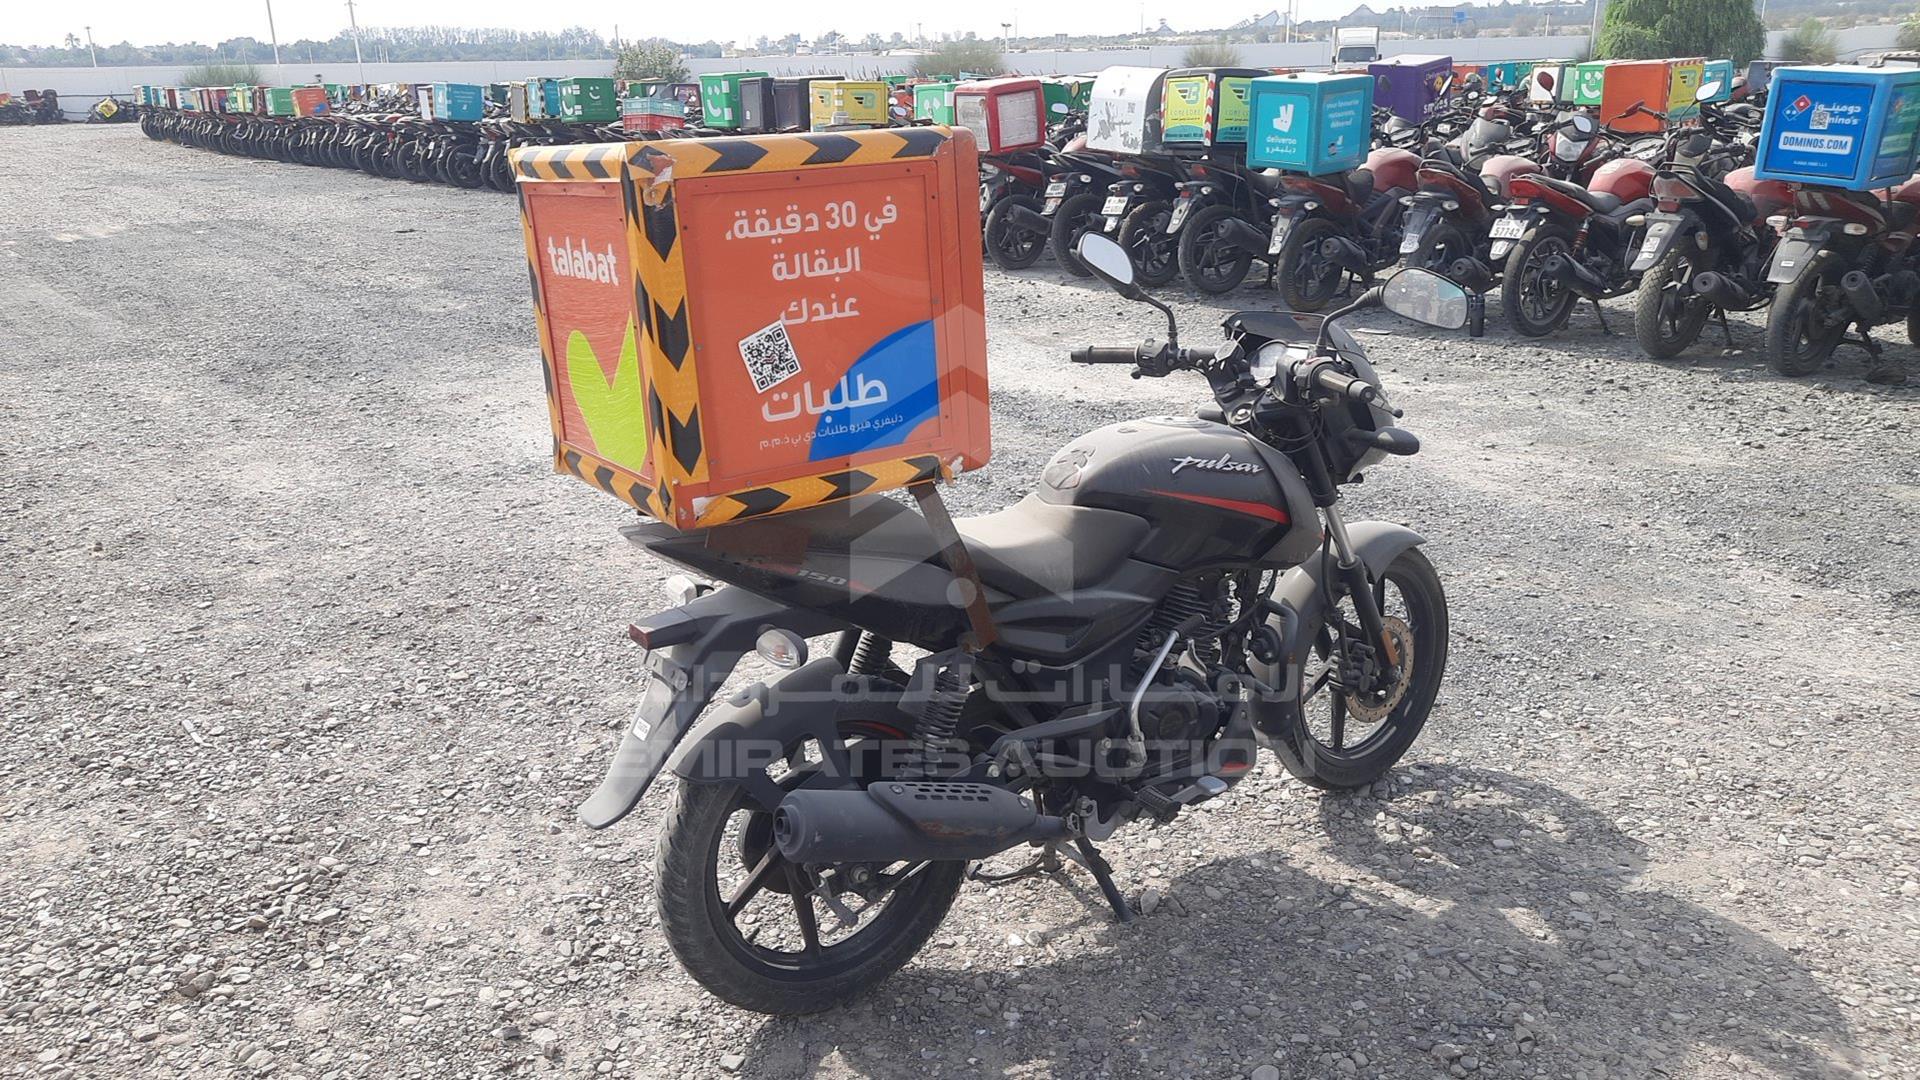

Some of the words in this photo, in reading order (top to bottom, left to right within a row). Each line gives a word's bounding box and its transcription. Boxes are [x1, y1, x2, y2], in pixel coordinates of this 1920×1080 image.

[1782, 136, 1848, 150] DOMINOS.COM
[825, 200, 857, 230] 30
[864, 196, 898, 240] في
[1494, 226, 1520, 237] 57742
[547, 236, 619, 287] talabat
[772, 246, 861, 282] البقالة
[778, 293, 860, 326] عندك
[761, 373, 888, 423] طلبات
